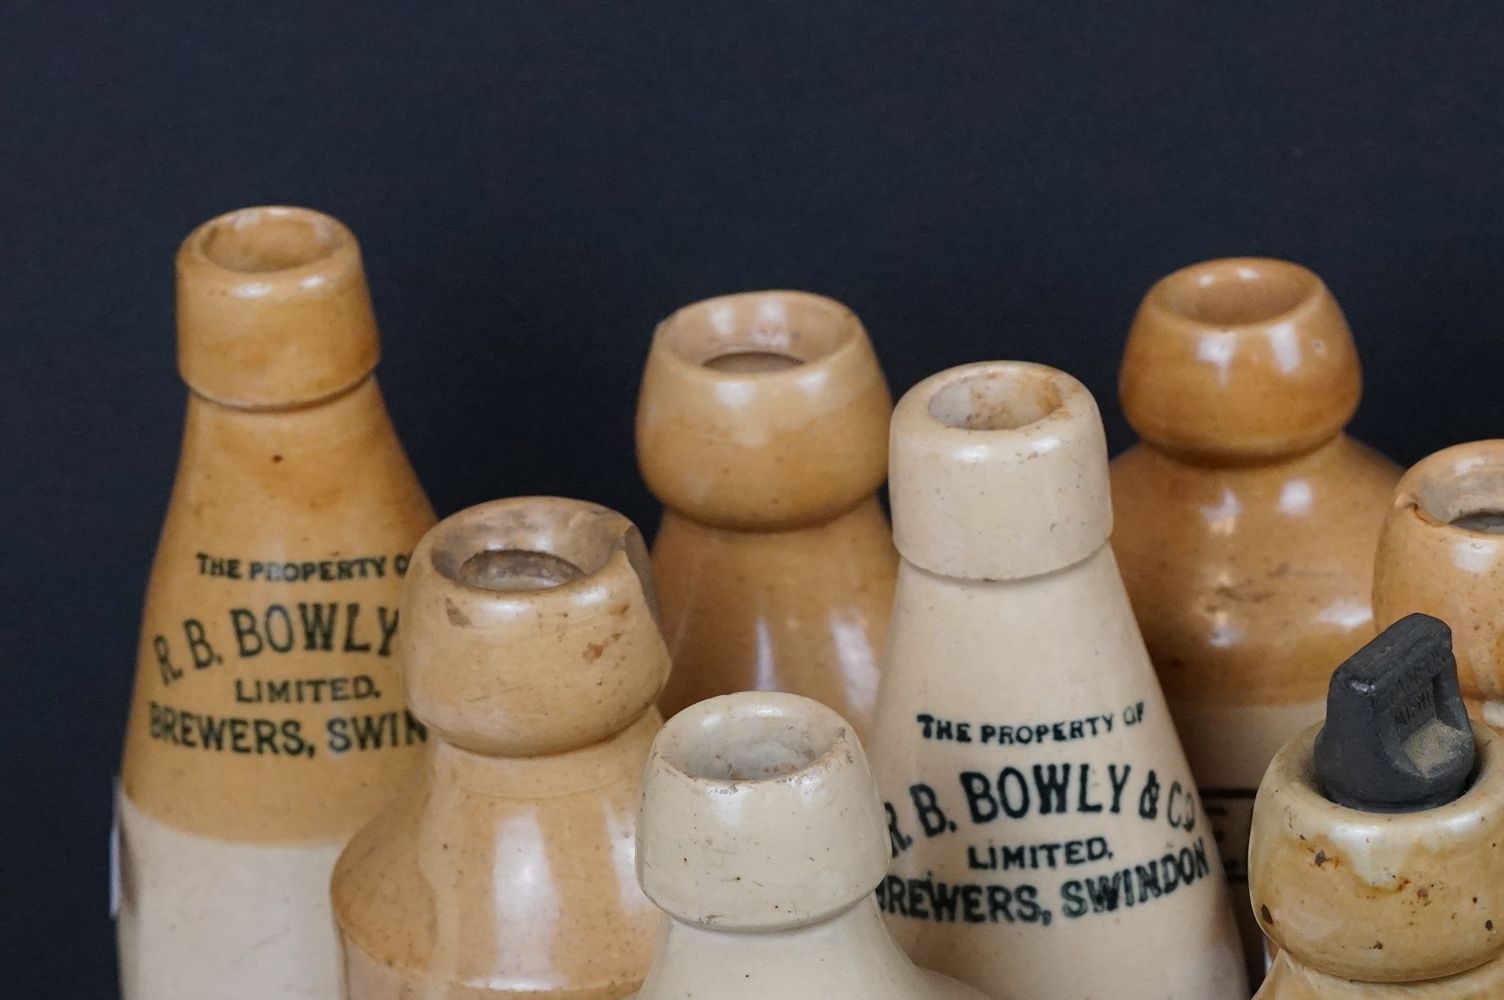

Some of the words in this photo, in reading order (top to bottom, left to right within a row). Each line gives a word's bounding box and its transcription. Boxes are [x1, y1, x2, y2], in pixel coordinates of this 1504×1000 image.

[195, 552, 241, 579] THE
[249, 556, 387, 583] PROPERTY
[230, 602, 400, 658] BOWLY
[236, 675, 382, 703] LIMITED.
[149, 700, 316, 758] BREWERS,
[916, 714, 972, 743] THE
[980, 714, 1113, 745] PROPERTY
[1122, 701, 1144, 725] OF
[960, 763, 1131, 825] BOWLY
[1139, 770, 1160, 820] &
[1060, 837, 1211, 919] SWINDON
